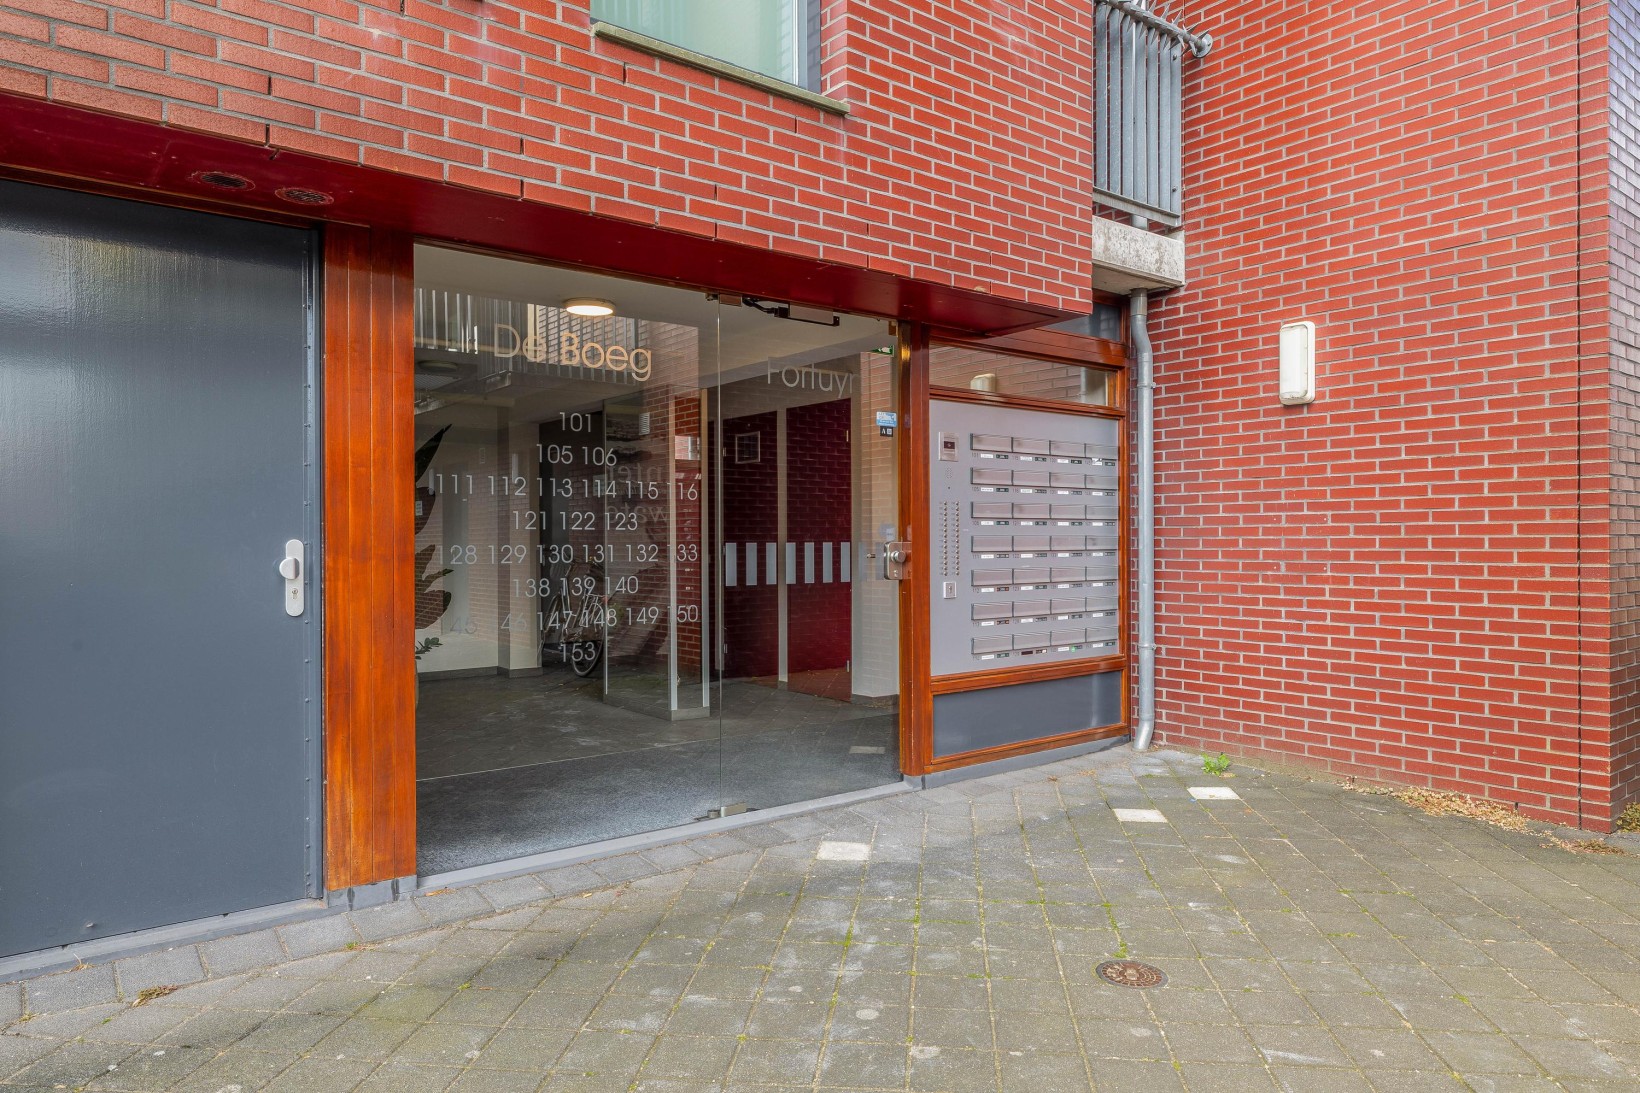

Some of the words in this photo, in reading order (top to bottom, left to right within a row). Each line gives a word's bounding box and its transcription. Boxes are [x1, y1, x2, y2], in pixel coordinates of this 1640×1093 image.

[494, 323, 546, 362] De
[560, 331, 652, 382] Boeg
[559, 411, 593, 433] 101
[536, 443, 574, 464] 105
[582, 446, 617, 467] 106
[436, 473, 474, 495] 111
[488, 475, 527, 496] 112
[536, 477, 573, 498] 113
[582, 478, 617, 499] 114
[625, 480, 659, 500] 115
[512, 510, 547, 530] 121
[559, 511, 596, 531] 122
[604, 512, 638, 531] 123
[436, 544, 478, 565] 128
[488, 544, 528, 565] 129
[536, 544, 574, 564] 130
[582, 544, 616, 563] 131
[625, 544, 659, 563] 132
[513, 578, 551, 598] 138
[559, 577, 596, 597] 139
[604, 575, 639, 595] 140
[536, 611, 574, 631] 147
[581, 608, 618, 628] 148
[625, 606, 660, 626] 149
[559, 641, 596, 663] 153
